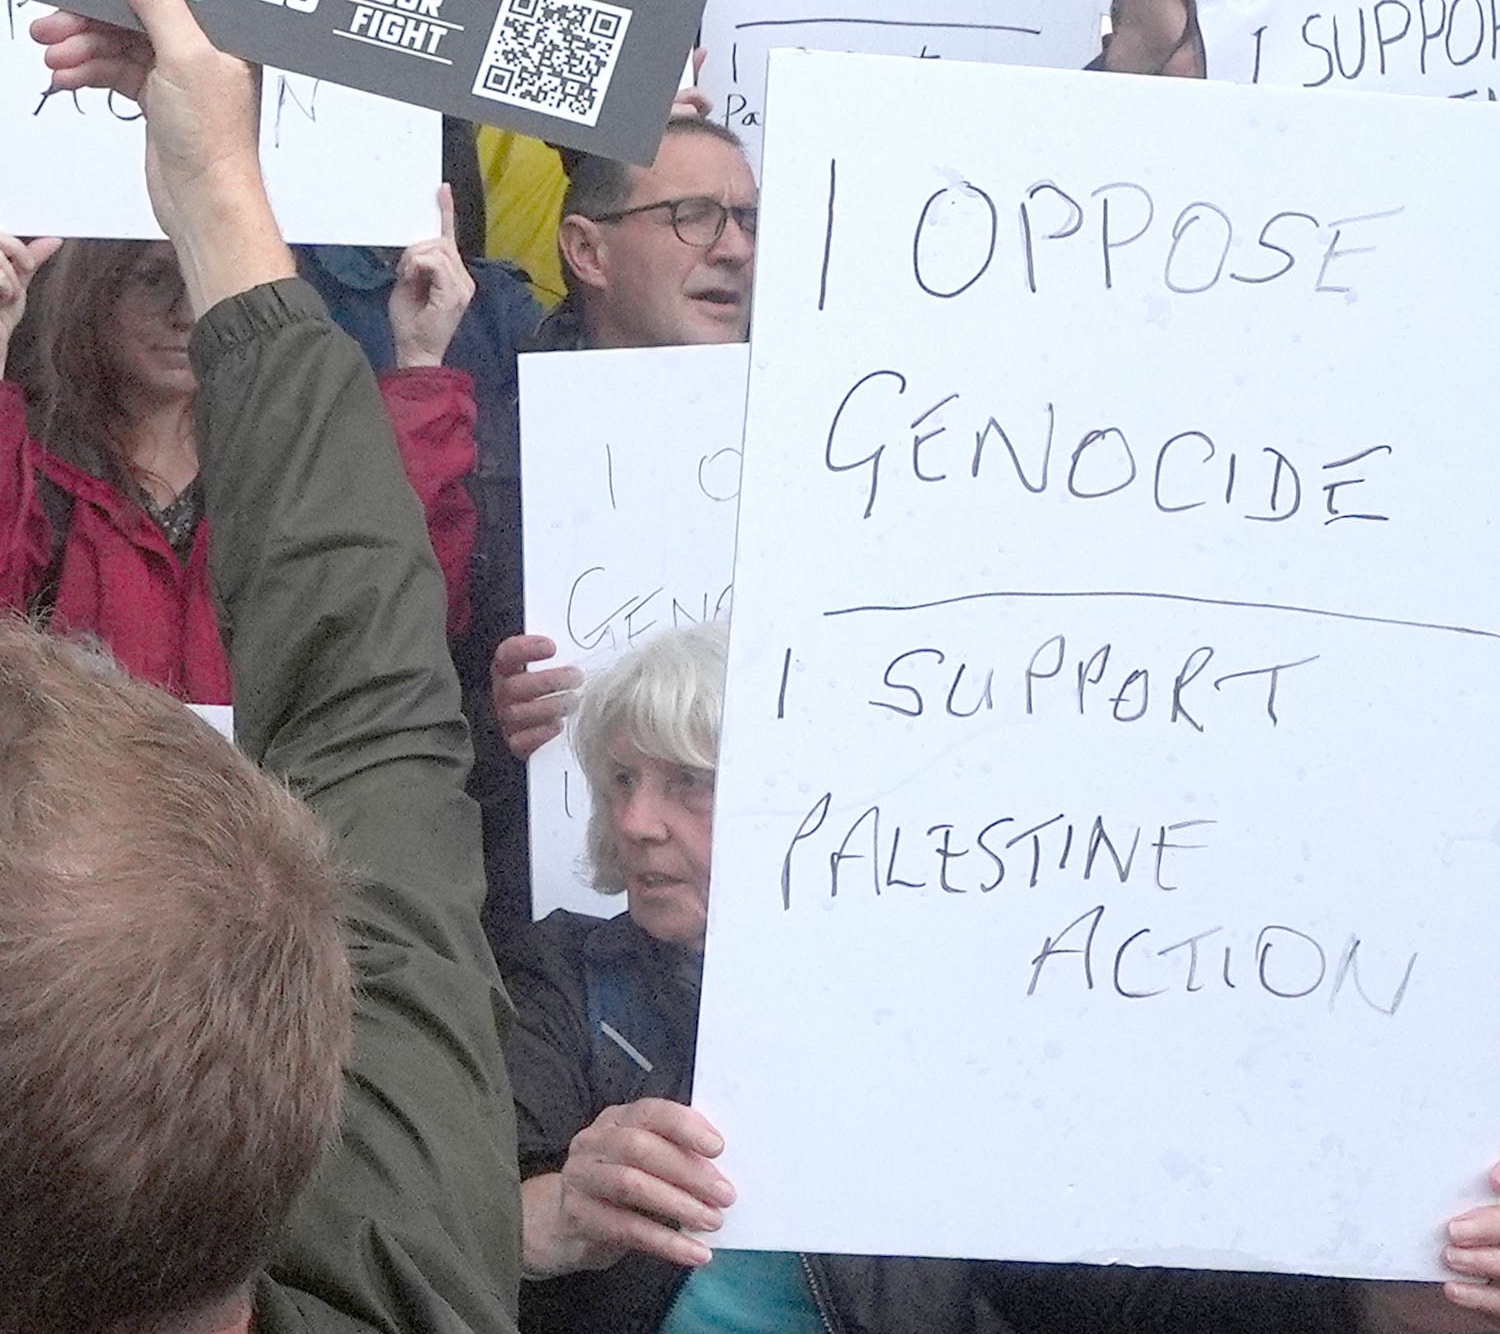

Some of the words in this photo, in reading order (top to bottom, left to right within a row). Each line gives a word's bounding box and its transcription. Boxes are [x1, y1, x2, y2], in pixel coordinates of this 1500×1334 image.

[349, 2, 450, 57] FIGHT
[1250, 26, 1263, 84] I
[818, 159, 836, 312] I
[912, 179, 1405, 299] OPPOSE
[824, 369, 1395, 525] GENOCIDE
[777, 649, 789, 720] I
[868, 637, 1323, 733] SUPPORT
[780, 792, 1217, 911] PALESTINE
[1027, 906, 1420, 1017] ACTION
